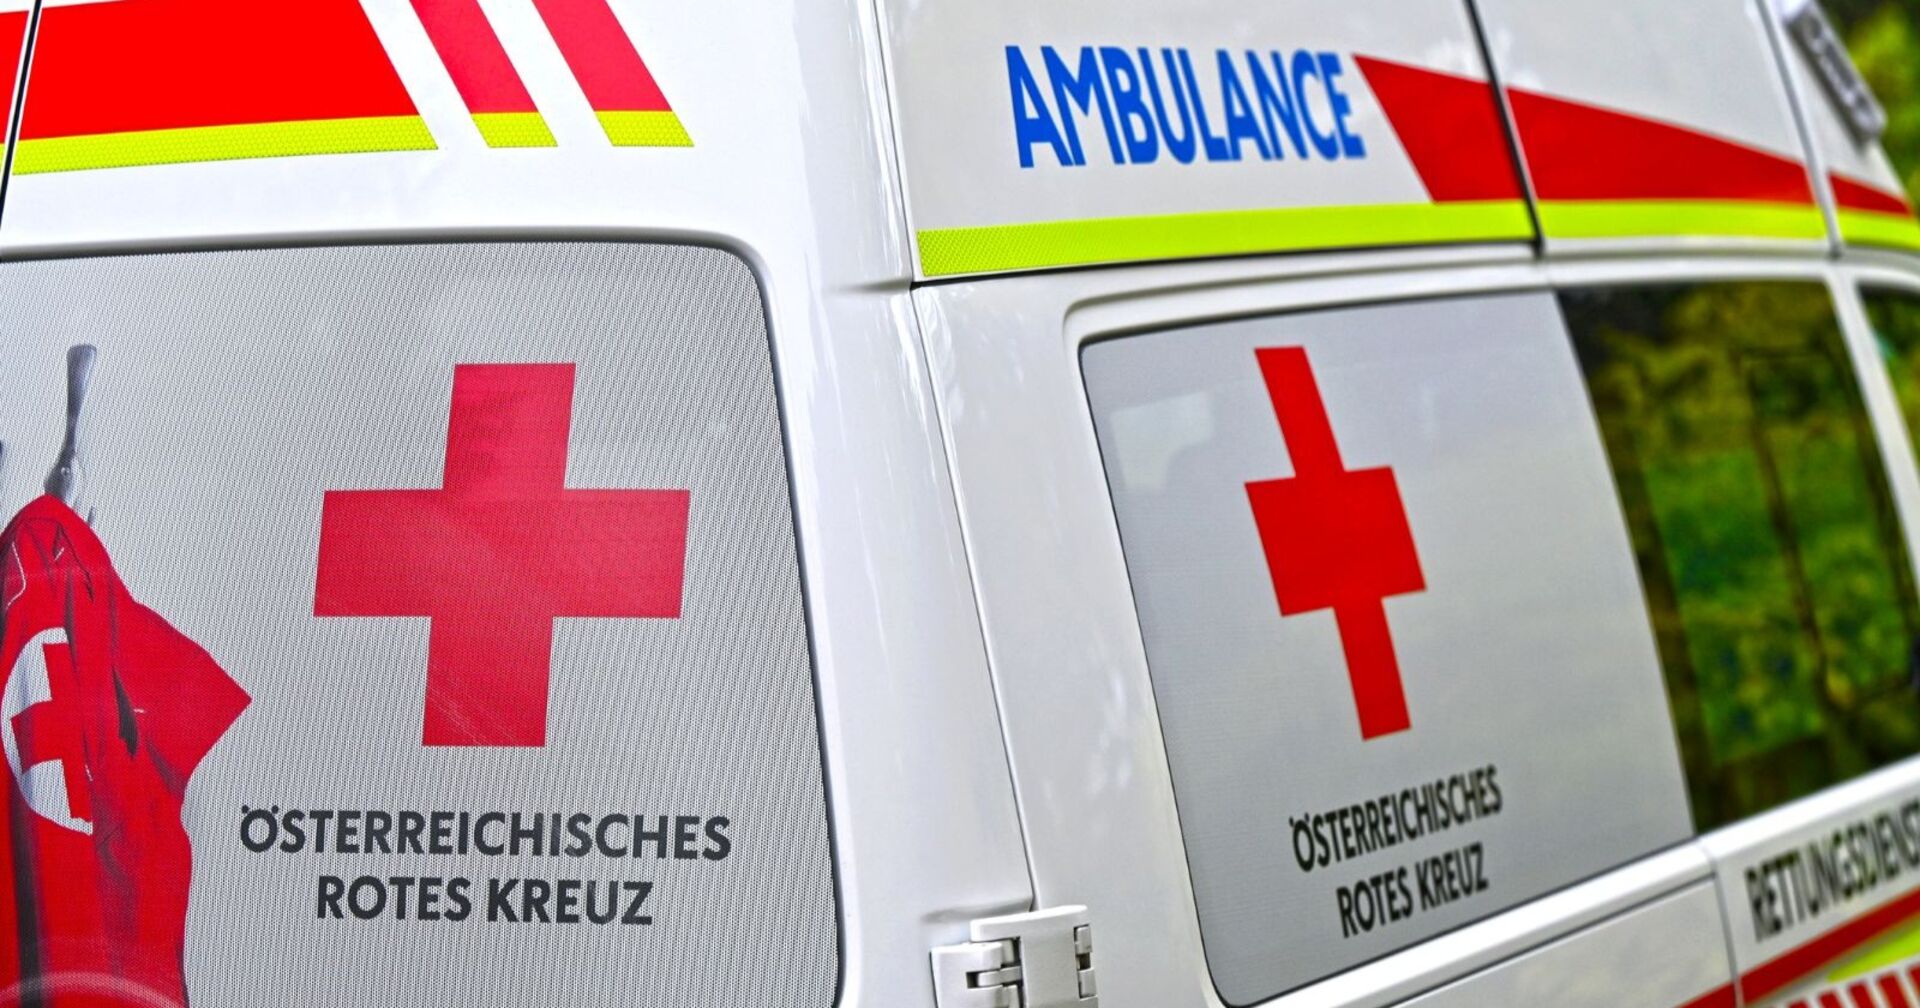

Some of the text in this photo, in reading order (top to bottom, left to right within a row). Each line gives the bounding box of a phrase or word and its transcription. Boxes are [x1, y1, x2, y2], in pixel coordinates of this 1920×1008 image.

[1005, 45, 1366, 168] AMBULANCE
[240, 805, 732, 861] ÖSTERREICHISCHES
[1289, 764, 1503, 872] ÖSTERREICHISCHES
[317, 875, 654, 926] ROTES KREUZ
[1336, 841, 1489, 939] ROTES KREUZ
[1744, 797, 1920, 943] RETTUNGSDIENS
